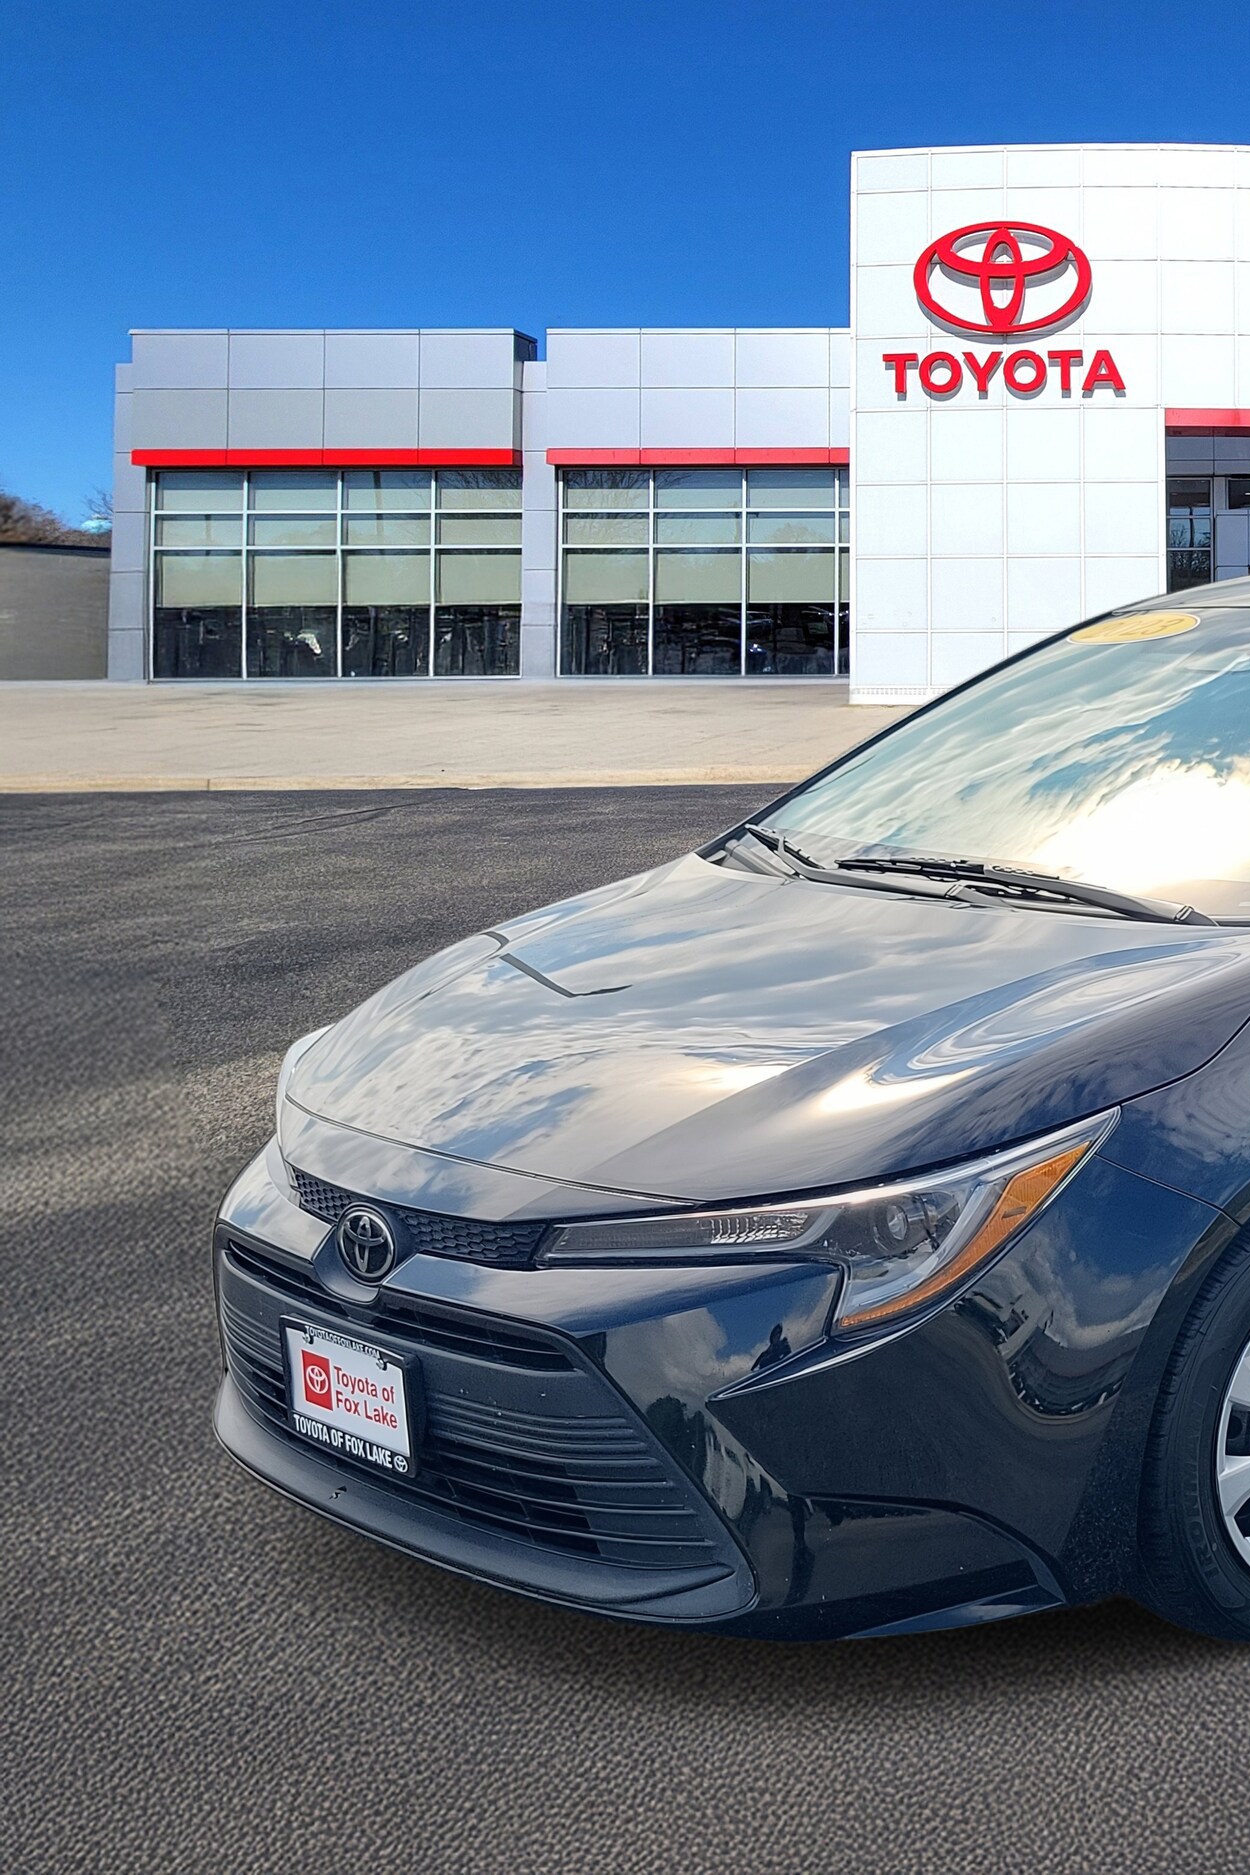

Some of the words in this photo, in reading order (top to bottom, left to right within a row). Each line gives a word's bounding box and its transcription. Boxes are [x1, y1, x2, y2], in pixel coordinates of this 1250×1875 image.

[883, 350, 1126, 396] TOYOTA
[334, 1366, 378, 1398] Toyota
[382, 1386, 394, 1404] of
[336, 1390, 361, 1416] Fox
[364, 1400, 398, 1429] Lake
[293, 1414, 330, 1443] TOYOTA
[331, 1429, 343, 1447] OF
[345, 1434, 365, 1457] FOX
[366, 1443, 392, 1468] LAKE
